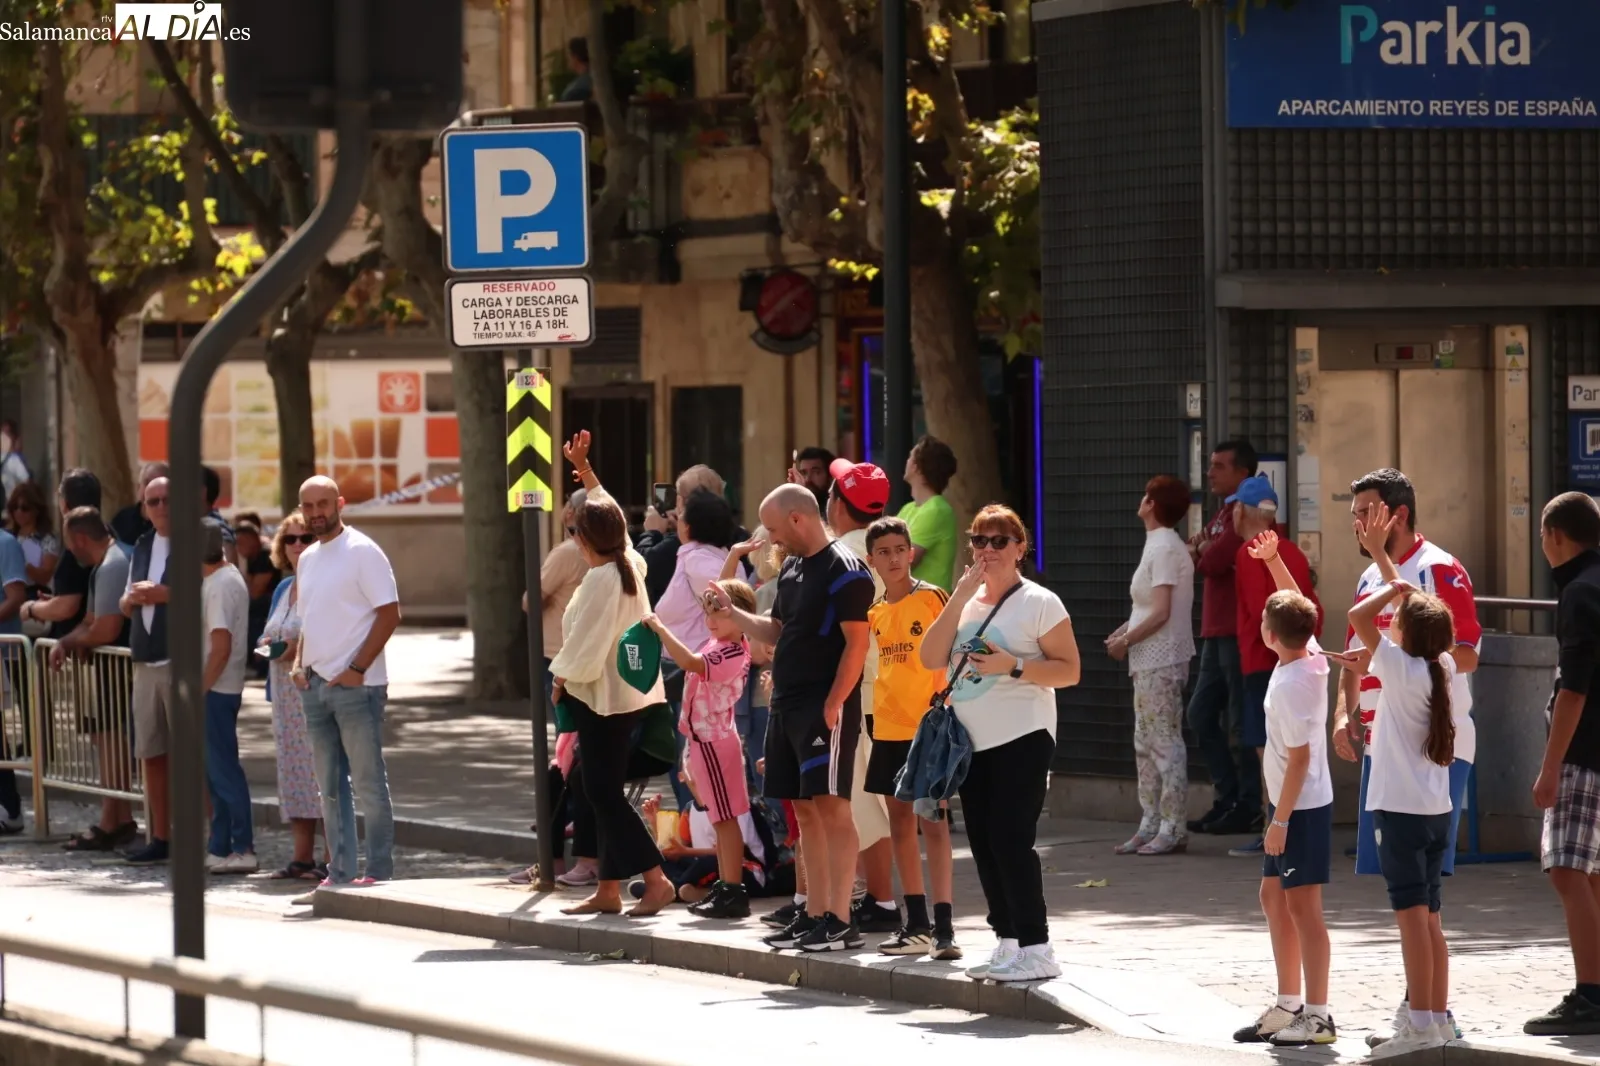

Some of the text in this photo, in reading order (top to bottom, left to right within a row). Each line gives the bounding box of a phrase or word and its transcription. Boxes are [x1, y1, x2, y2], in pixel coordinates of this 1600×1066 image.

[1340, 4, 1531, 65] Parkia
[1277, 97, 1598, 117] APARCAMIENTO REYES DE ESPAÑA
[473, 147, 557, 254] P
[483, 281, 556, 293] RESERVADO
[462, 294, 579, 308] CARGA Y DESCARGA
[473, 307, 568, 320] LABORABLES DE
[473, 319, 569, 332] 7 A 11 Y 16 A 18H.
[472, 332, 503, 340] TIEMPO
